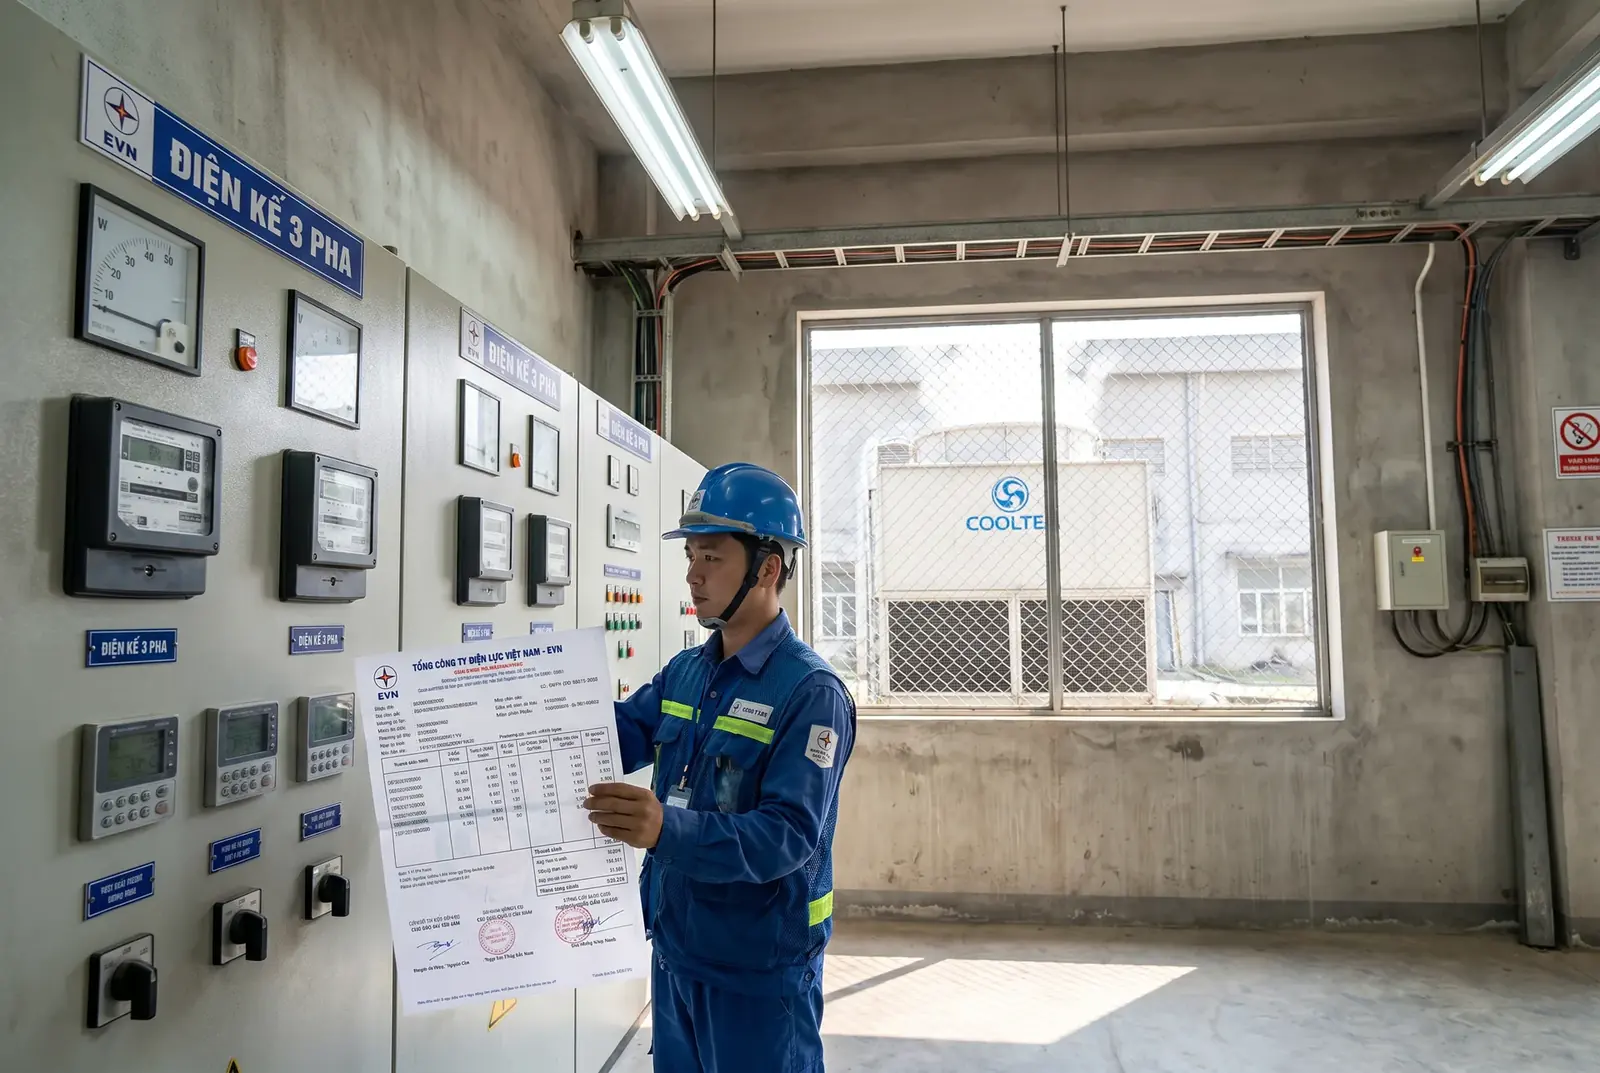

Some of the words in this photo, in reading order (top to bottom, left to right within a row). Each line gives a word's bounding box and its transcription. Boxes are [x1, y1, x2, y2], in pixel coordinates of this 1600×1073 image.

[104, 130, 137, 161] EVN
[170, 137, 241, 213] ĐIỆN
[250, 188, 286, 237] KẾ
[289, 215, 303, 248] 3
[310, 226, 352, 278] PHA
[98, 216, 108, 232] W
[124, 255, 135, 268] 30
[144, 252, 154, 262] 40
[110, 268, 122, 280] 20
[104, 289, 114, 300] 10
[489, 340, 514, 375] ĐIỆN
[516, 358, 530, 382] KẾ
[531, 368, 537, 388] 3
[540, 374, 557, 400] PHA
[322, 635, 326, 645] 3
[327, 634, 338, 645] PHA
[101, 638, 124, 658] ĐIỆN
[126, 636, 140, 655] KẾ
[141, 641, 147, 654] 3
[149, 640, 167, 654] PHA
[457, 657, 467, 666] TY
[469, 653, 486, 665] ĐIỆN
[505, 649, 520, 661] VIỆT
[523, 648, 540, 657] NAM
[546, 645, 562, 654] EVN
[378, 691, 399, 700] EVN
